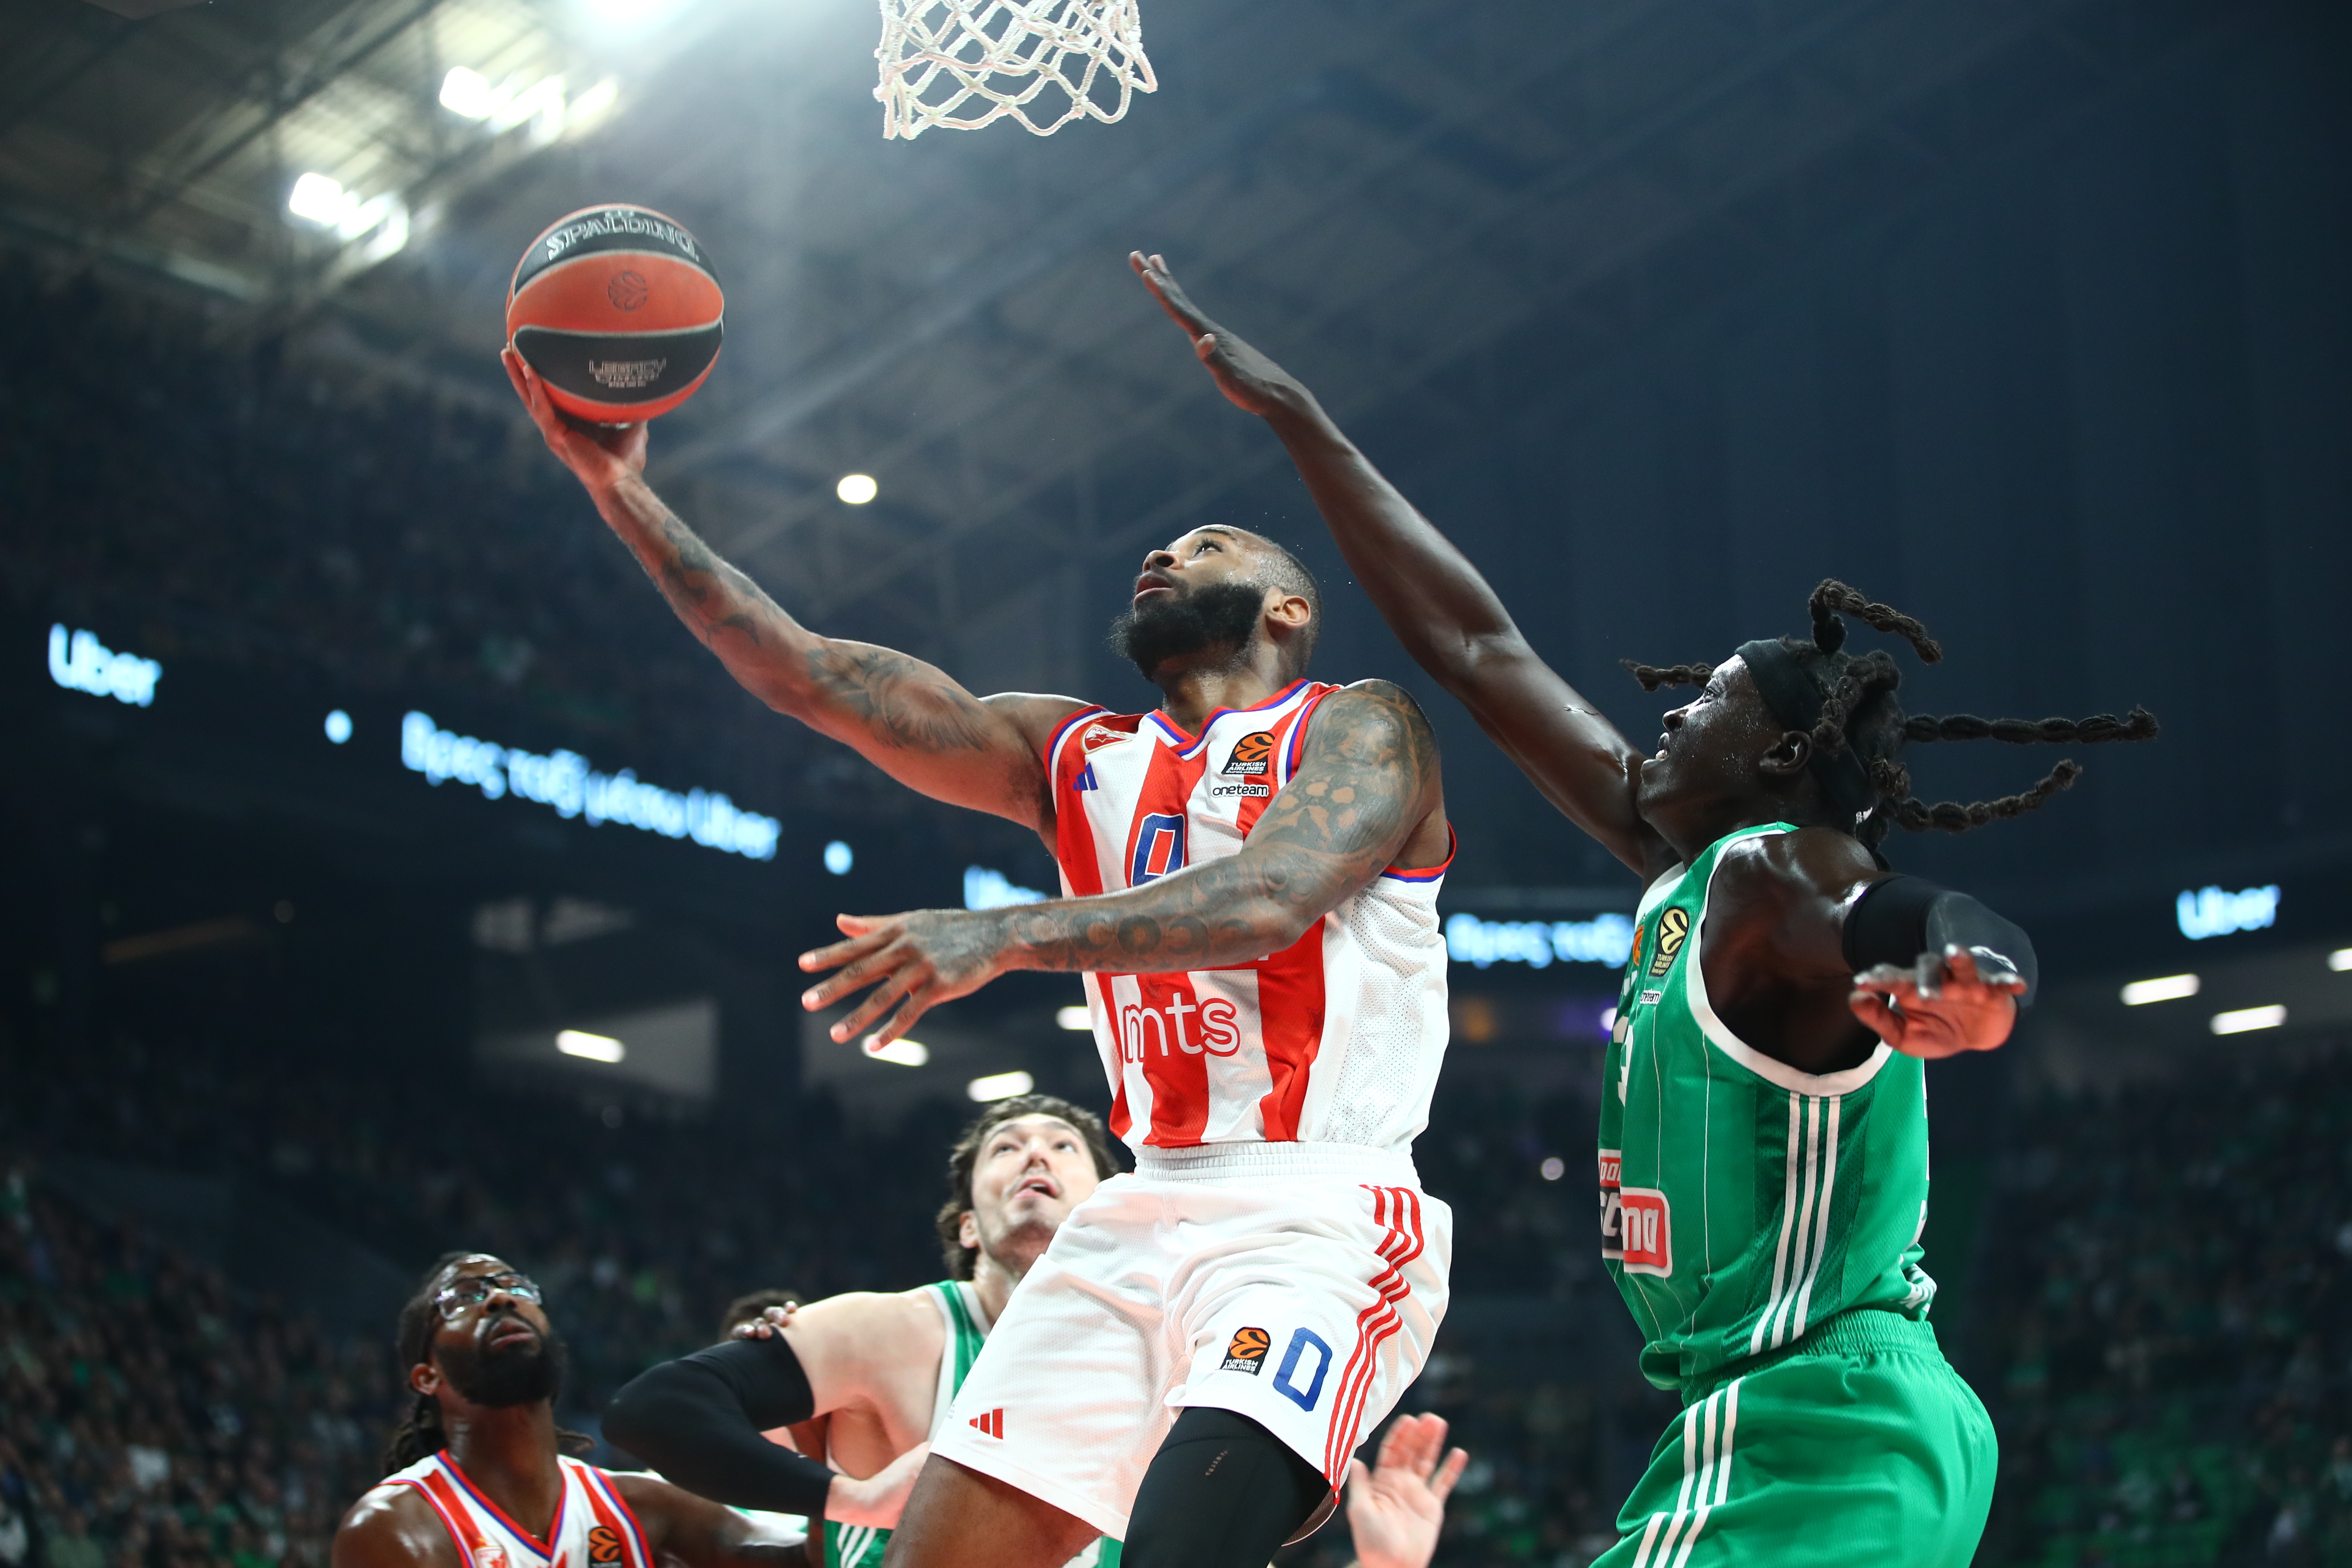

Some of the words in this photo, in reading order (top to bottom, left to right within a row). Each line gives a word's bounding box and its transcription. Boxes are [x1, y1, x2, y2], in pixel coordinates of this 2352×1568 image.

[546, 216, 696, 260] SPALDING
[1213, 784, 1268, 796] oneteam
[1123, 992, 1241, 1063] mts
[1222, 1363, 1256, 1372] AIRLINES
[1225, 1358, 1259, 1367] TURKISH
